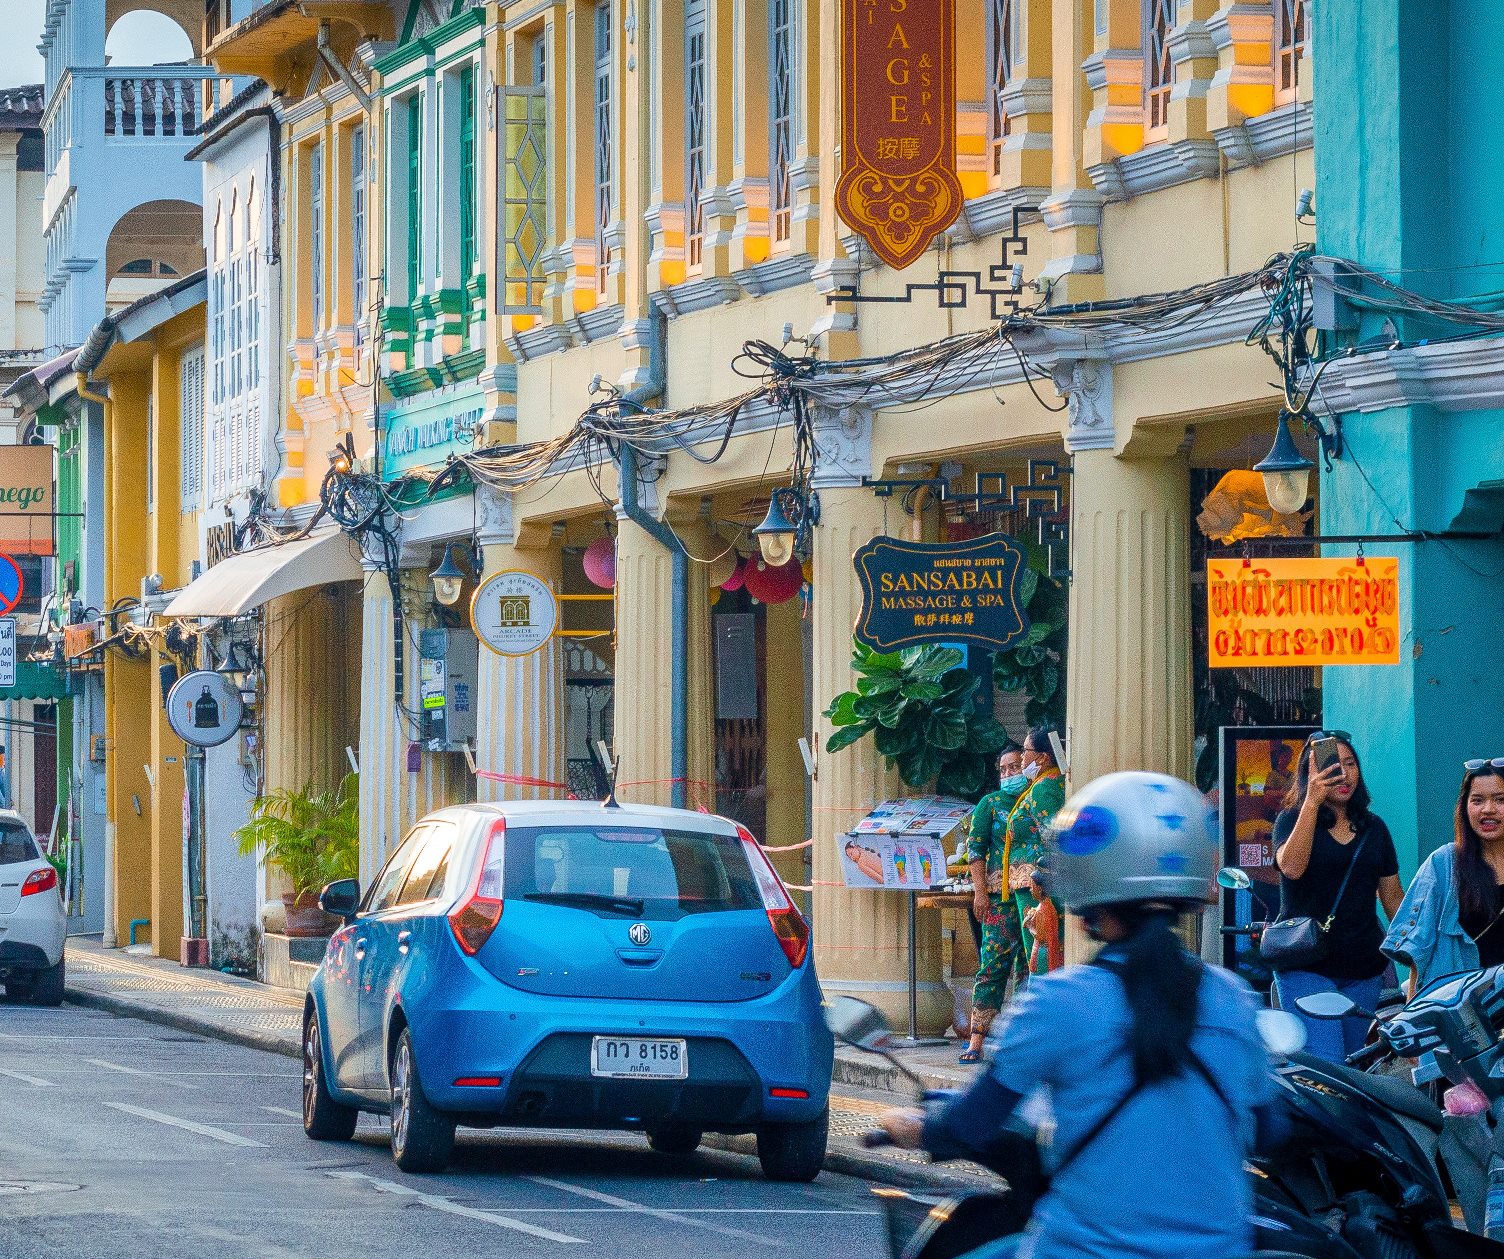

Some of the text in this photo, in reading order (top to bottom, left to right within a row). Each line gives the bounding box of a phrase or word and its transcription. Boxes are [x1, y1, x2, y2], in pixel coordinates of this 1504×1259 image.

[876, 136, 921, 160] 按摩
[880, 570, 1004, 593] SANSABAI
[881, 593, 1005, 610] MASSAGE & SPA
[630, 925, 650, 941] MG
[605, 1040, 680, 1062] กว 8158
